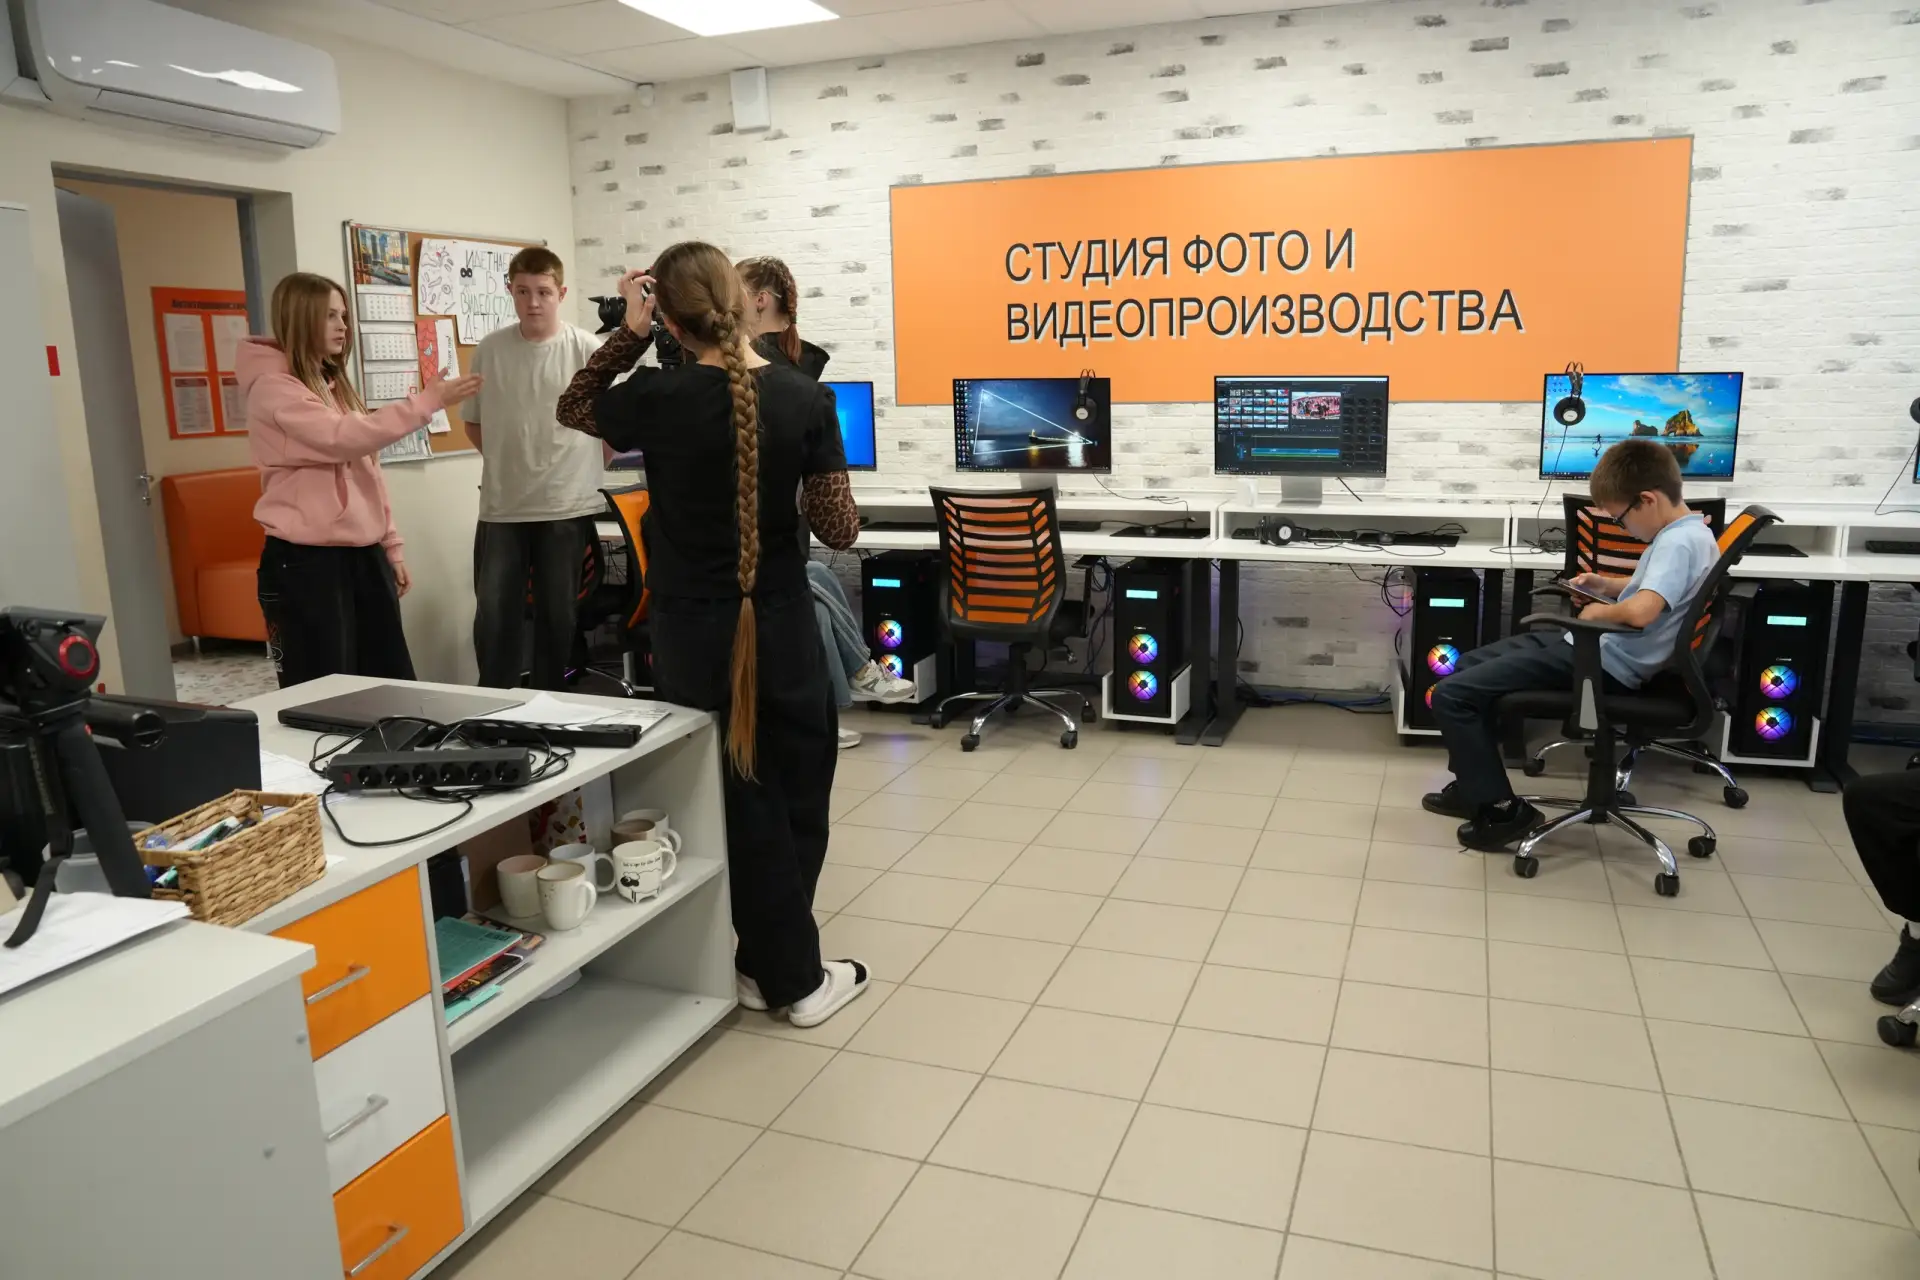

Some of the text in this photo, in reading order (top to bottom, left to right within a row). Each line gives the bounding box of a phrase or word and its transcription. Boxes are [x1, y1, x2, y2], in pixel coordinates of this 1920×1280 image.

[1005, 228, 1355, 287] СТУДИЯ ФОТО И
[1007, 289, 1524, 348] ВИДЕОПРОИЗВОДСТВА
